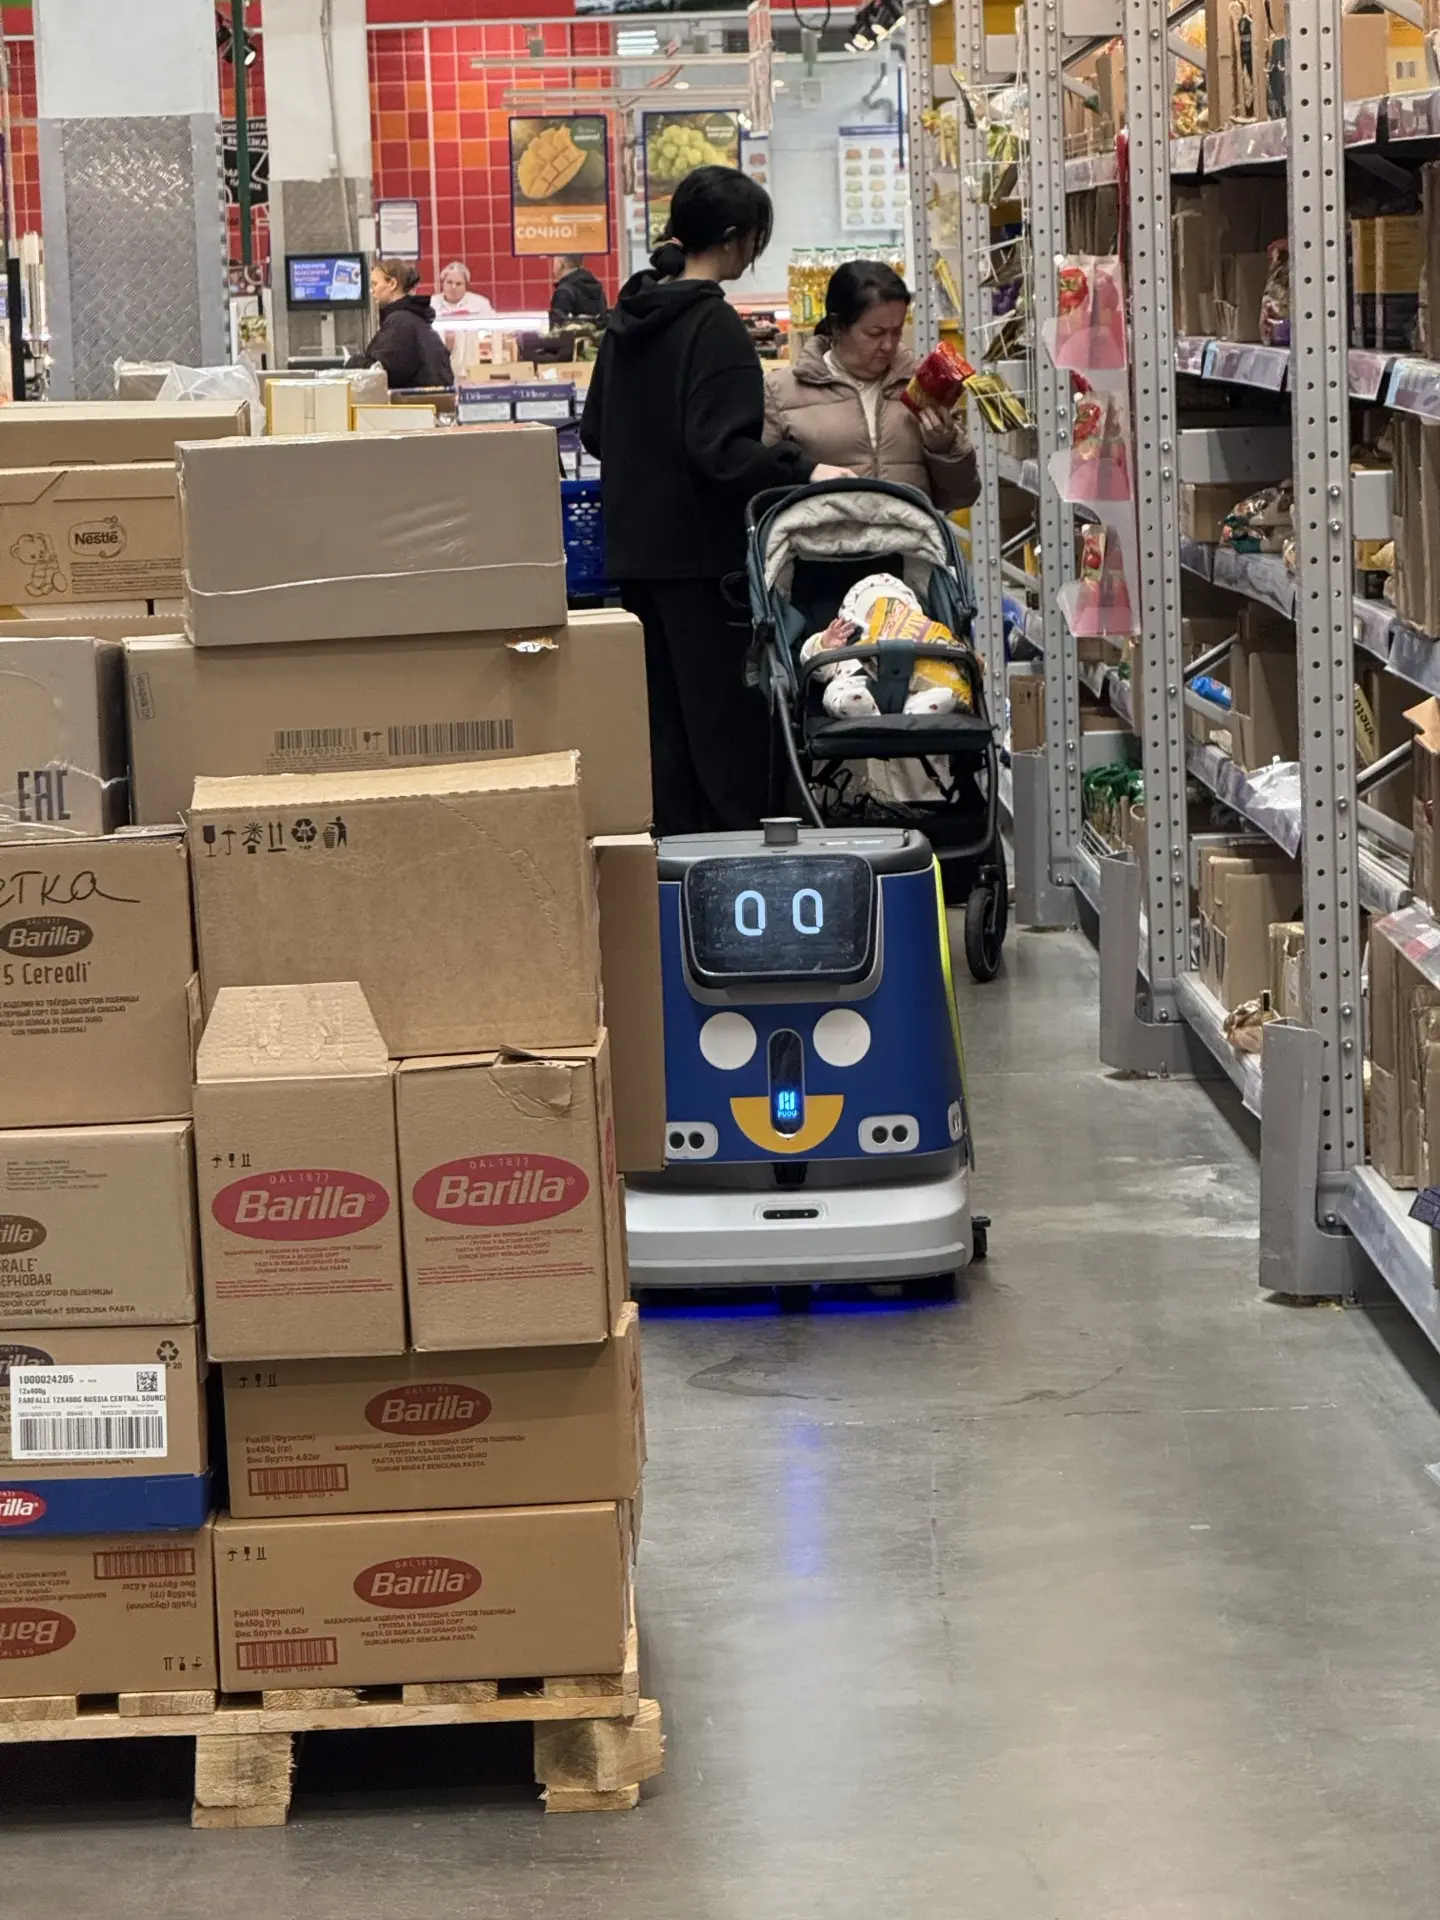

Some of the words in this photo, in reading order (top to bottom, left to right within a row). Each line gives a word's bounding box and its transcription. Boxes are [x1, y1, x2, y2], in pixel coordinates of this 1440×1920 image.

[517, 224, 577, 239] СОЧНО!
[8, 926, 81, 948] Barilla
[3, 963, 14, 985] 5
[777, 1109, 797, 1118] PUDU
[470, 1159, 496, 1170] DAL
[500, 1156, 530, 1168] 1877
[269, 1175, 295, 1185] DAL
[299, 1173, 329, 1183] 1877
[435, 1170, 566, 1210] Barilla
[235, 1186, 366, 1223] Barilla
[70, 1288, 114, 1297] ПШЕНИЦЫ
[34, 1307, 64, 1315] WHEAT
[65, 1305, 107, 1314] SEMOLINA
[109, 1303, 136, 1313] PASTA
[172, 1361, 182, 1370] 20
[18, 1375, 75, 1385] 1000024205
[18, 1395, 52, 1404] FARFALLE
[53, 1395, 82, 1404] 12X400G
[83, 1394, 109, 1403] RUSSIA
[110, 1393, 139, 1403] CENTRAL
[381, 1395, 475, 1424] Barilla
[247, 1455, 264, 1464] Вес
[370, 1568, 465, 1597] Barilla
[266, 1618, 281, 1628] (гр)
[235, 1630, 252, 1638] Вес
[253, 1629, 282, 1639] брутто
